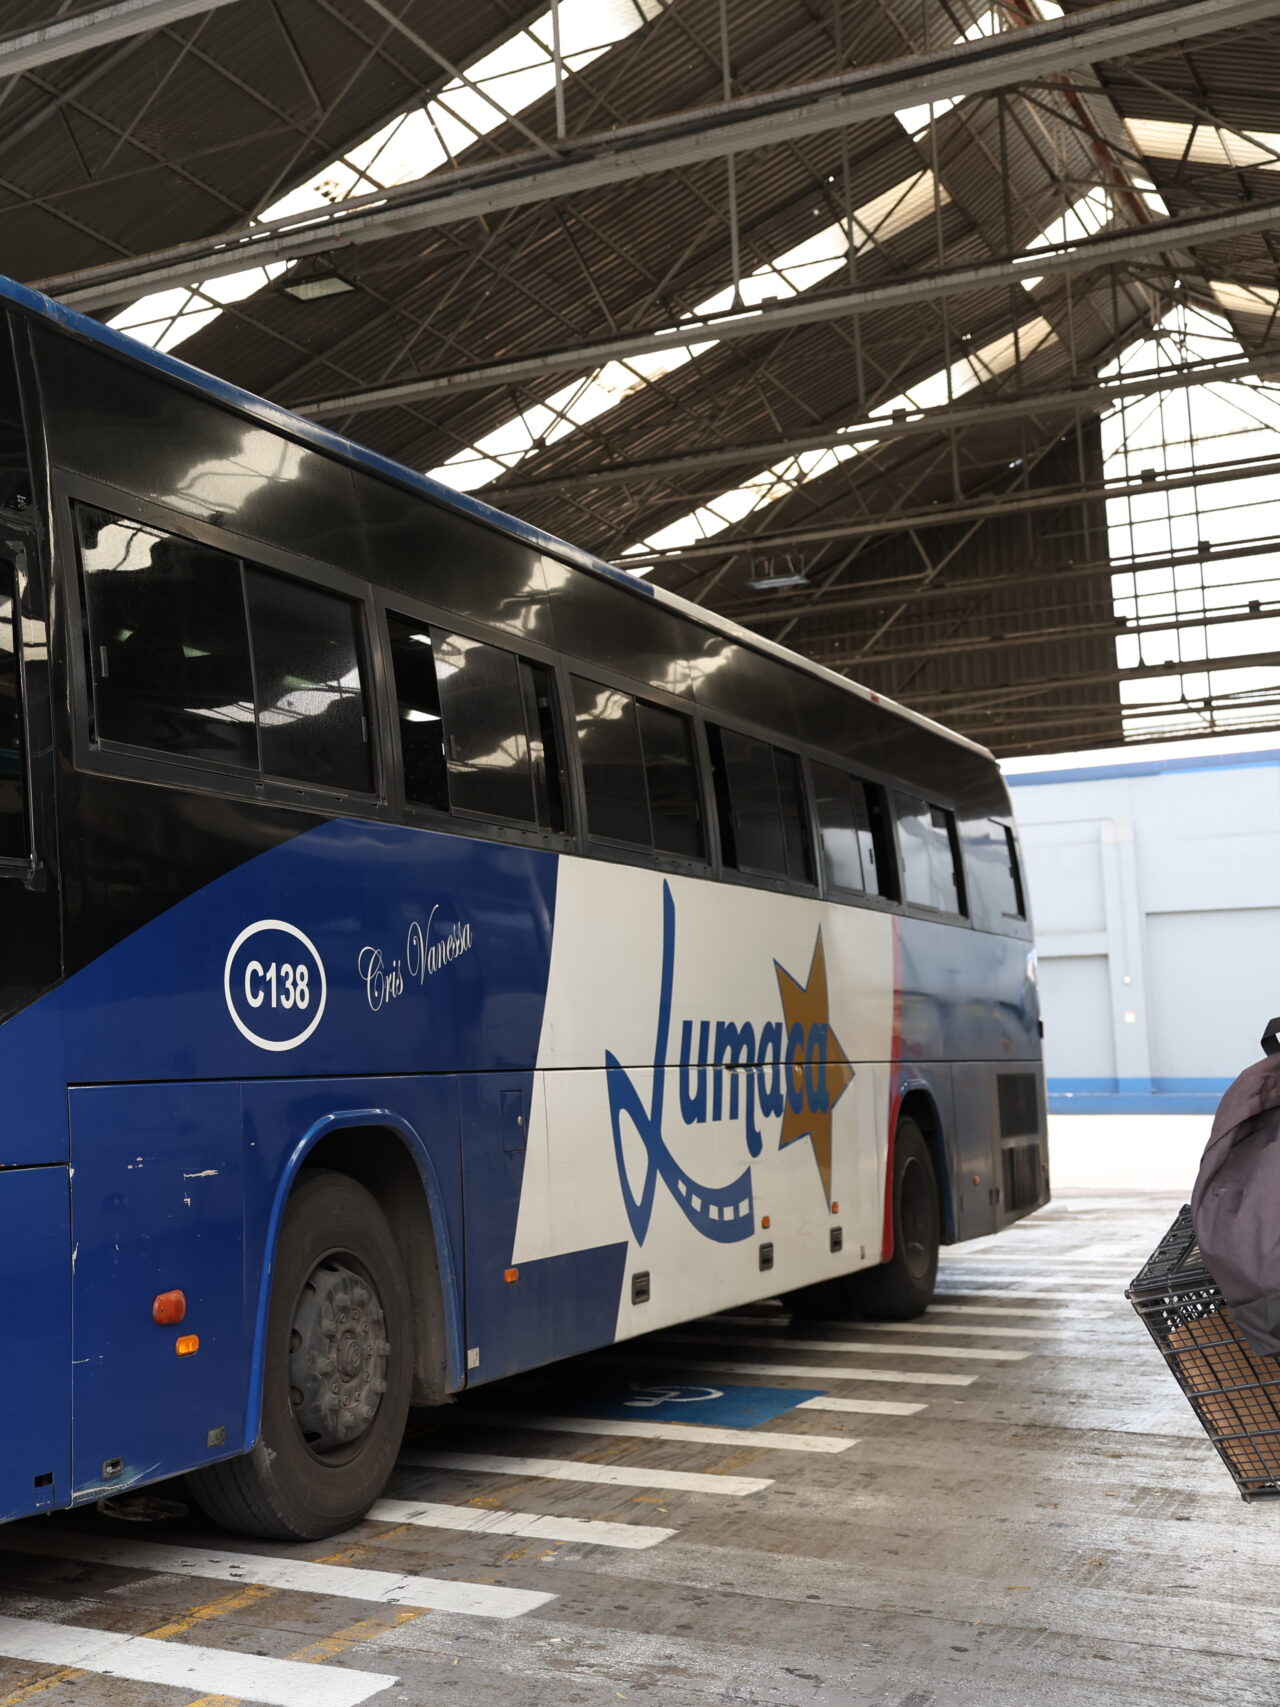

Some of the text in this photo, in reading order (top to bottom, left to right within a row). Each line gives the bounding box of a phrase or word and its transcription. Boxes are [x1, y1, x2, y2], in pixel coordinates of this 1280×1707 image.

[245, 960, 310, 1010] C138
[358, 904, 472, 1012] Cris Vanessa
[605, 878, 830, 1248] Lumaca
